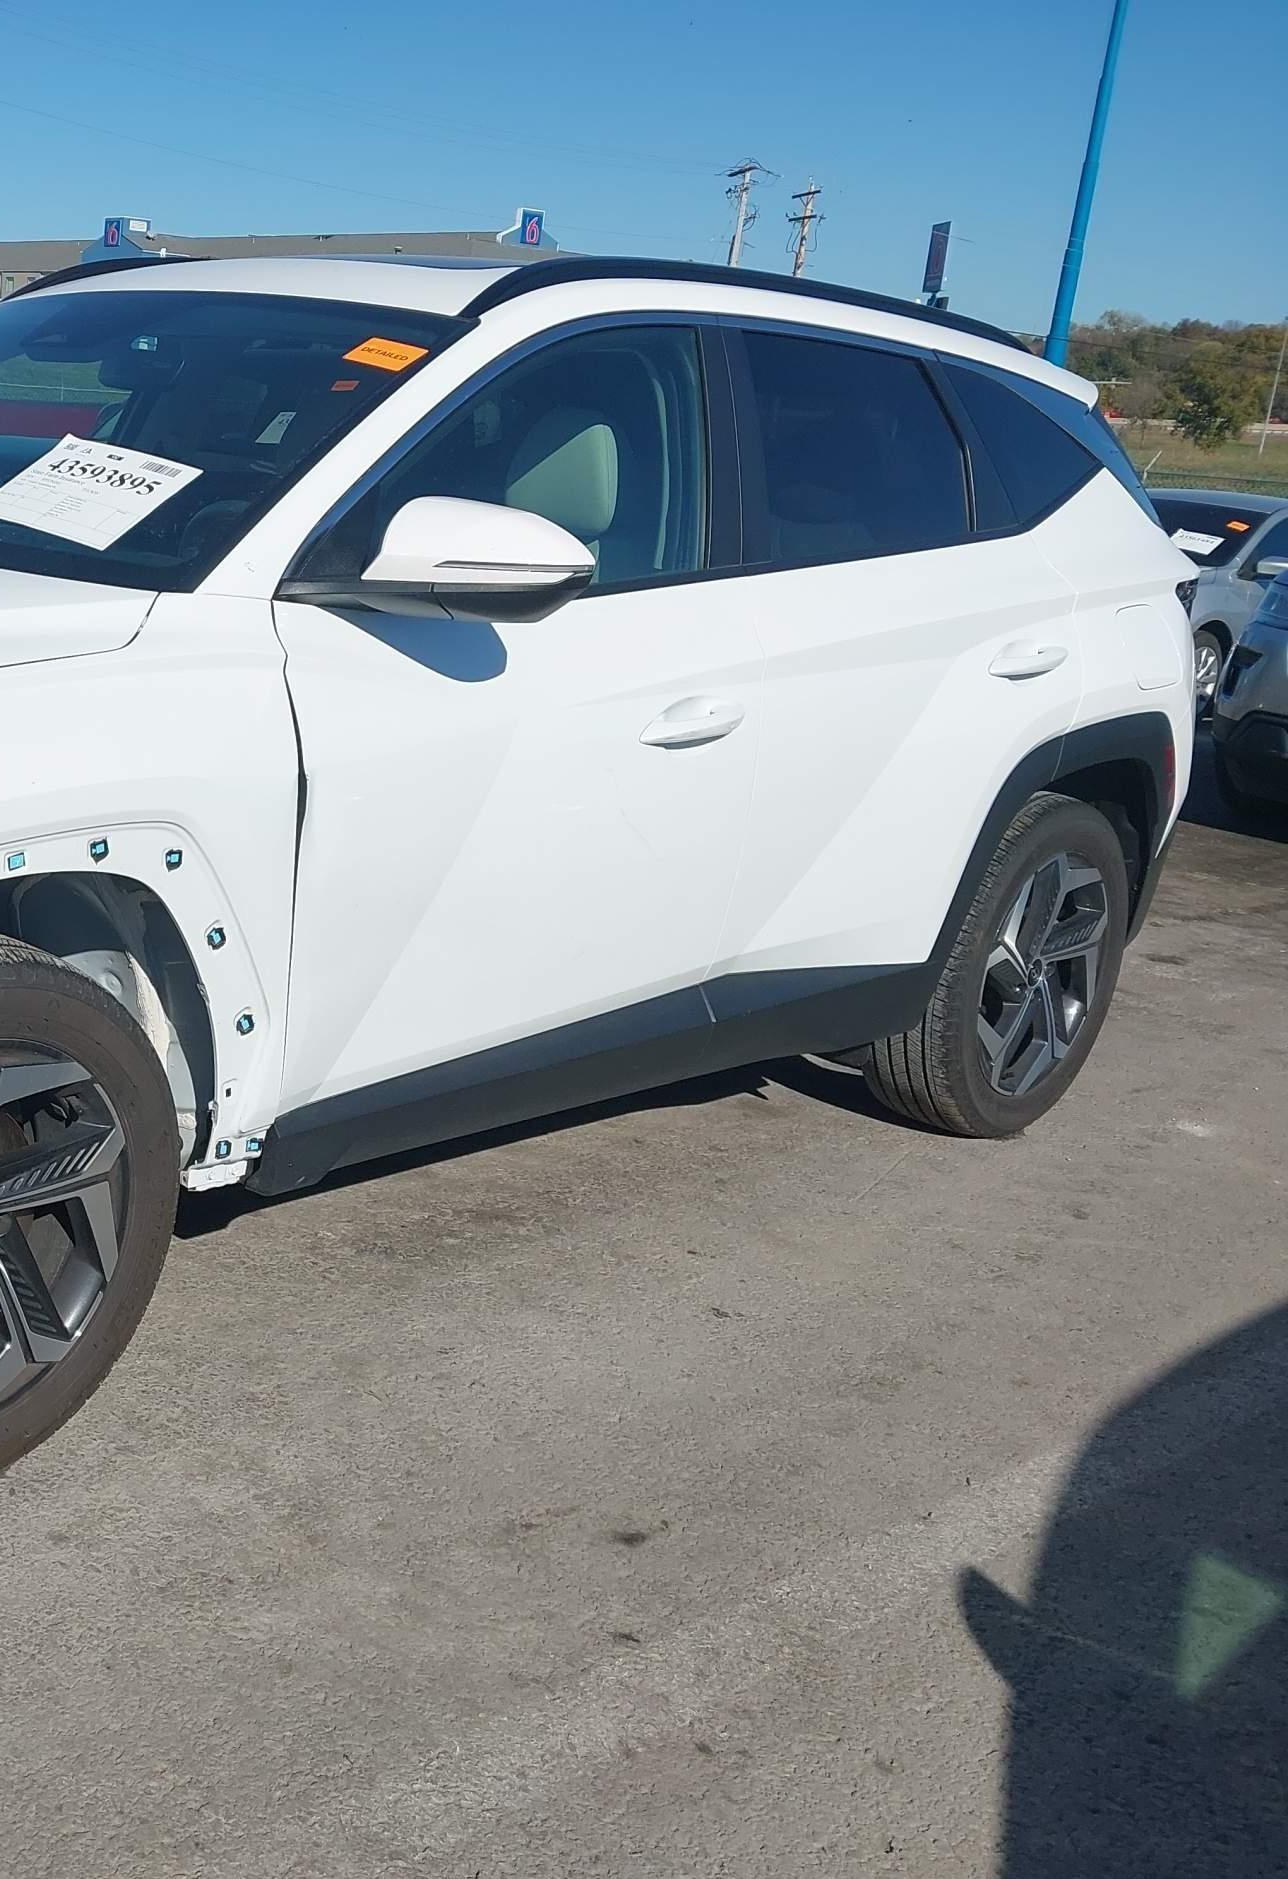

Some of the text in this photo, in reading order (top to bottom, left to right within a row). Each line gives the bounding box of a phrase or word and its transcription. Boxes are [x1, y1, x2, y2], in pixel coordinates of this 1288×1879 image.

[107, 222, 118, 246] 6
[526, 216, 540, 244] 6
[361, 346, 409, 361] DETAILED
[47, 457, 162, 495] 43593895
